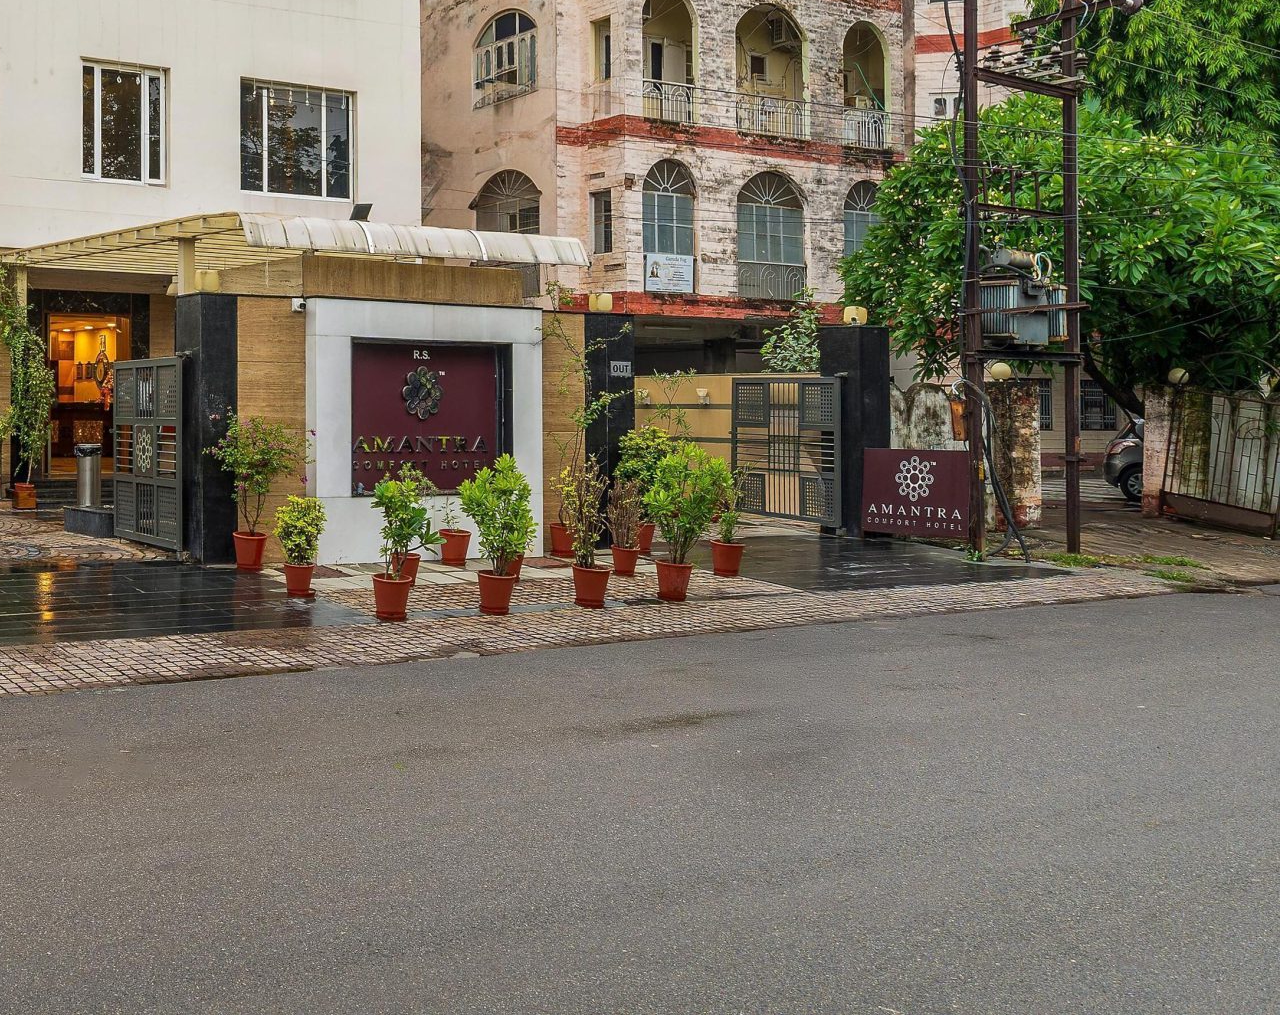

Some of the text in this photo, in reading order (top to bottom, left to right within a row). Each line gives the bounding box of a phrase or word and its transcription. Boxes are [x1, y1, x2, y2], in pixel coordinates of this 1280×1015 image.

[413, 350, 431, 360] R.S.
[612, 364, 629, 373] OUT
[352, 435, 489, 454] AMANTRA
[352, 460, 429, 470] COMFT
[868, 503, 962, 520] AMANTRA
[867, 516, 962, 531] COMFORT HOTEL
